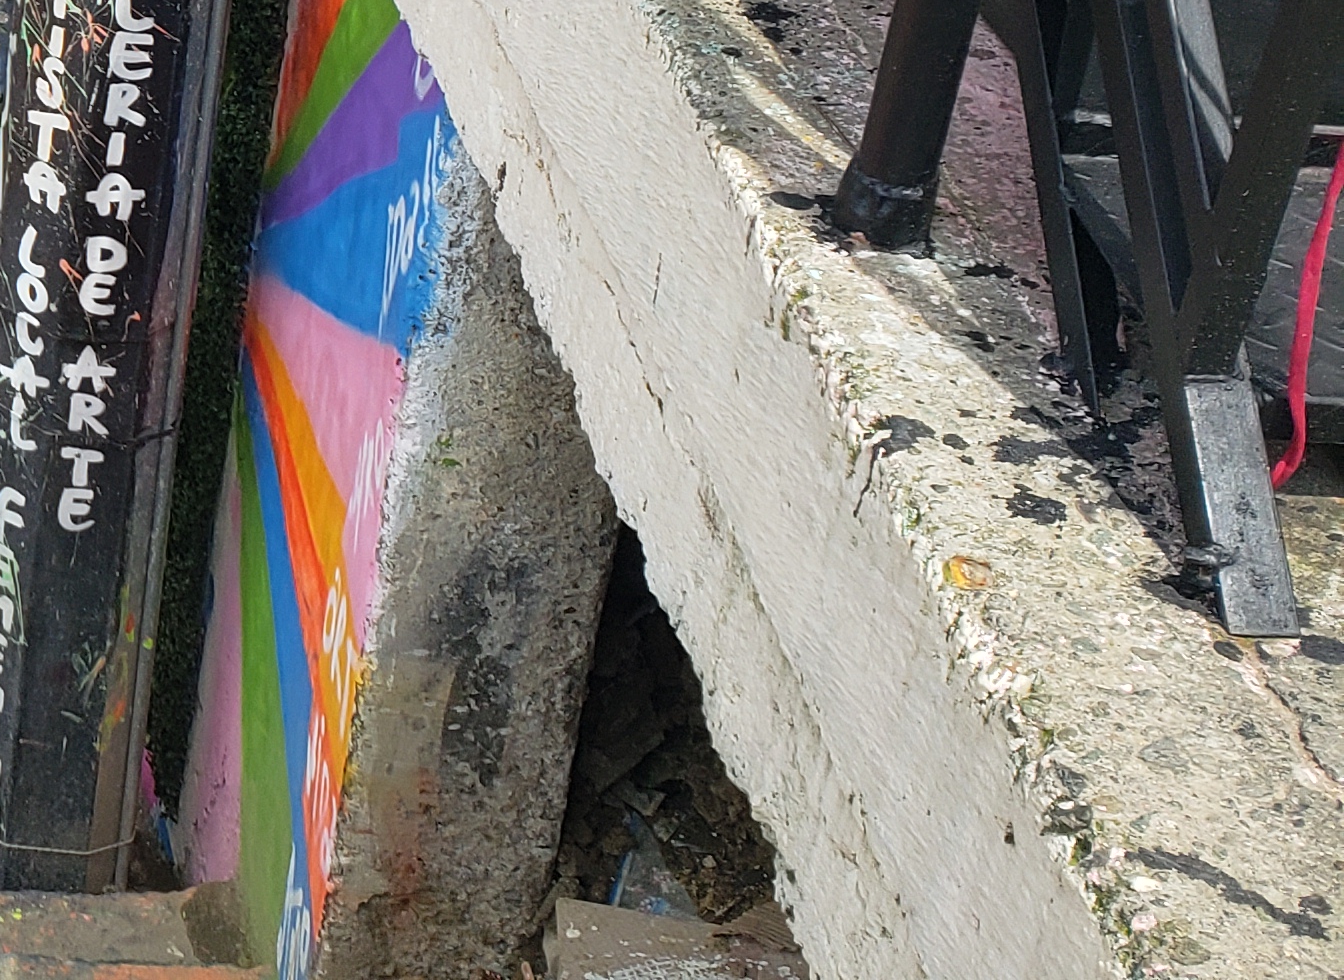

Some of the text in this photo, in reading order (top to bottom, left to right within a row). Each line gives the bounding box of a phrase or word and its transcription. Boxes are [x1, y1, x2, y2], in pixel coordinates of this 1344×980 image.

[0, 224, 50, 451] LOCAL
[78, 237, 128, 316] DE
[57, 344, 116, 532] ARTE
